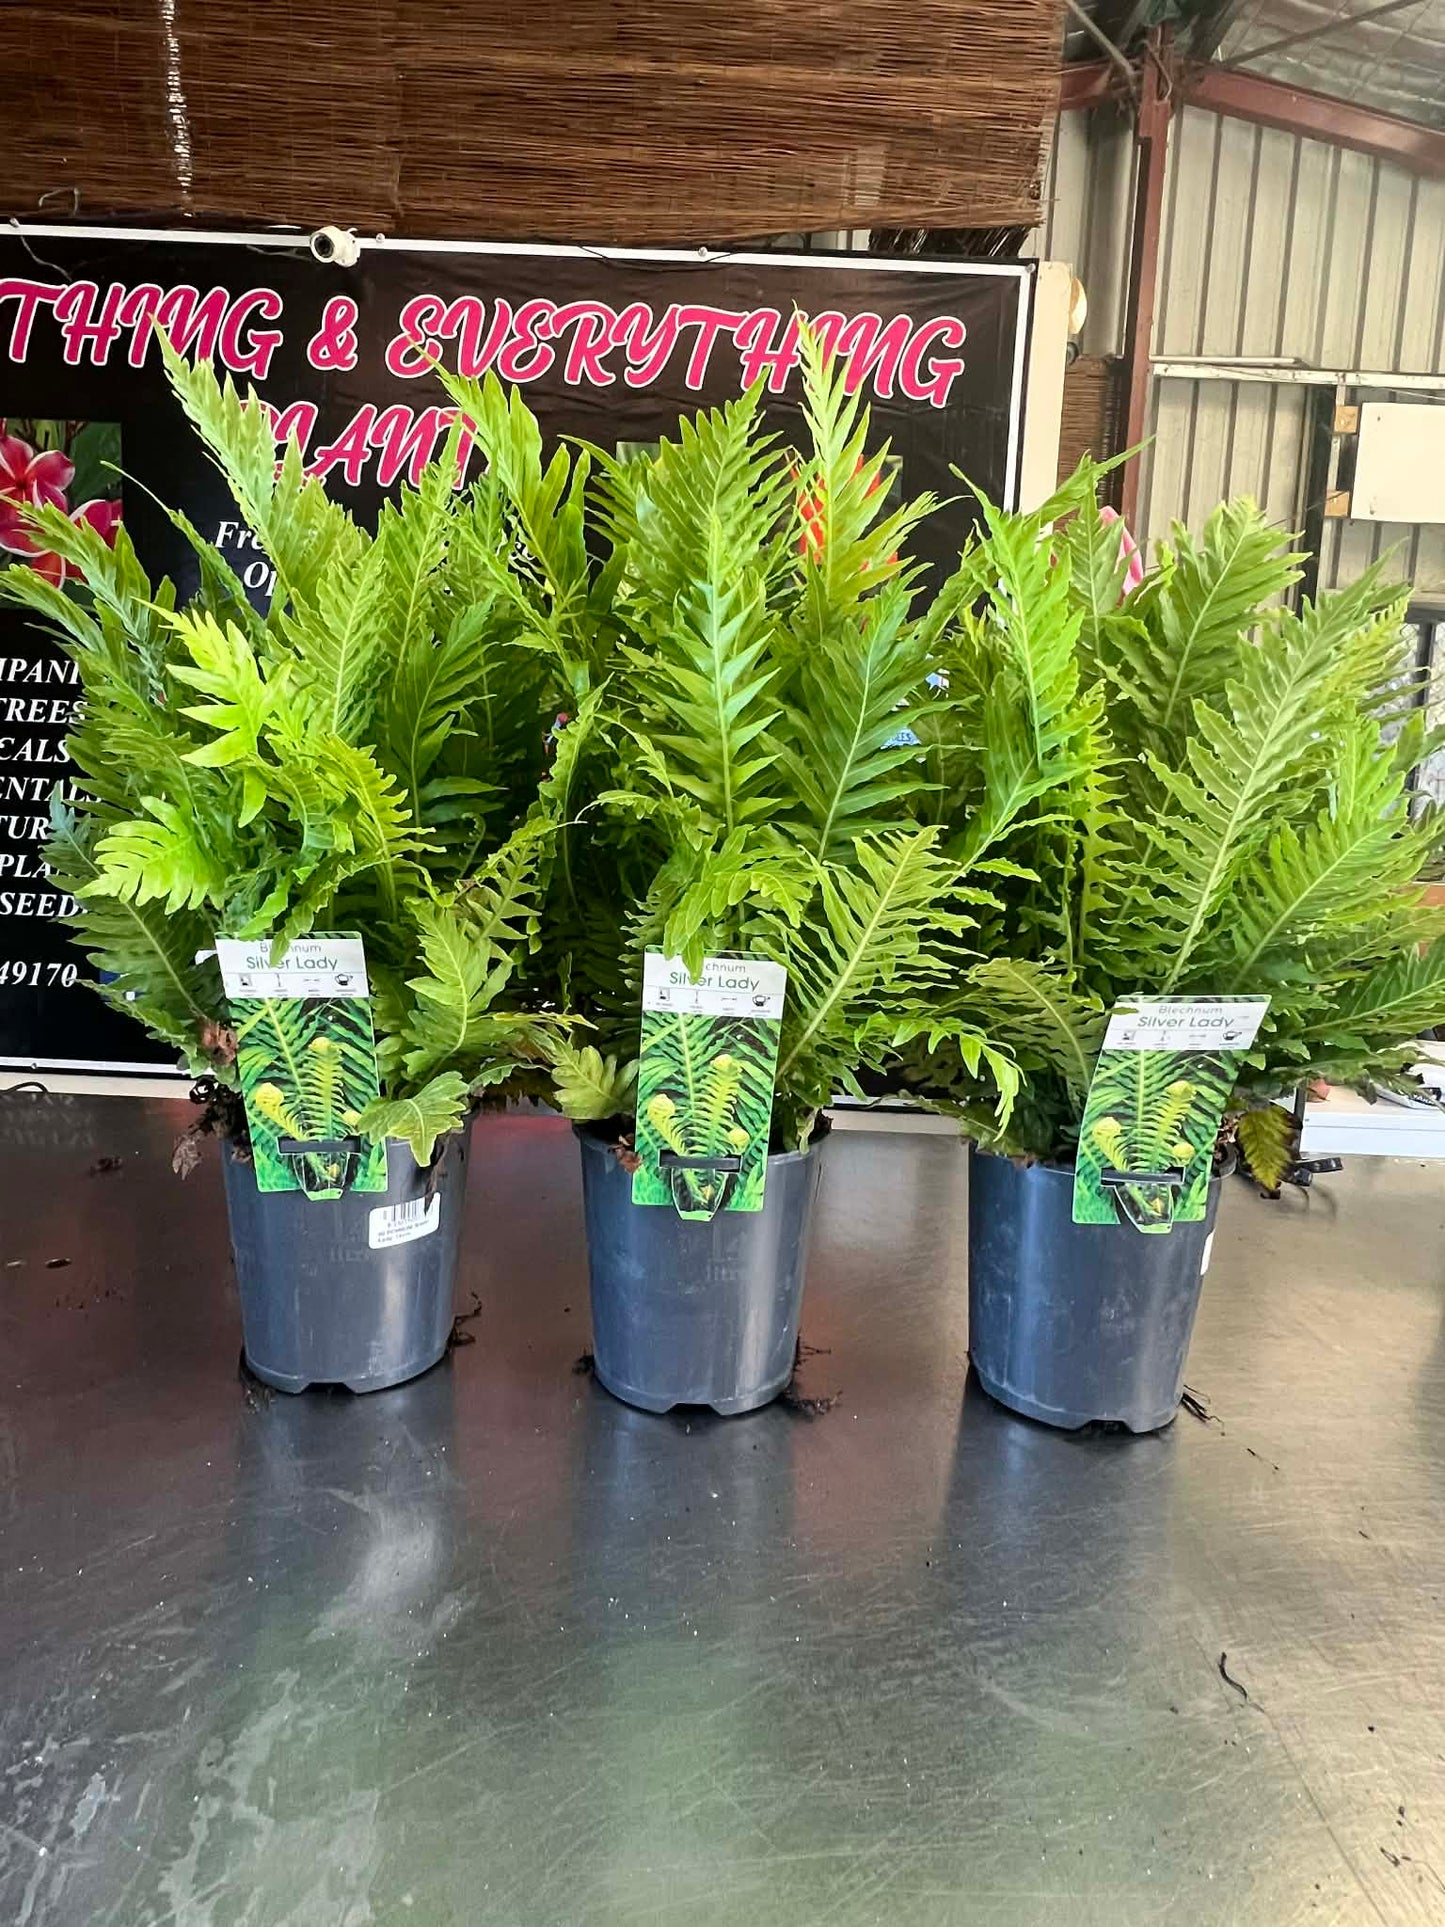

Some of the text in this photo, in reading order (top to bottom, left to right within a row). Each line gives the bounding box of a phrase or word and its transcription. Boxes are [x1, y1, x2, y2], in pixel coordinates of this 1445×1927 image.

[307, 295, 359, 371] &
[385, 294, 967, 408] EVERYTHING
[0, 776, 102, 803] NTAL
[0, 891, 88, 918] SEED
[296, 957, 338, 971] Lady
[669, 971, 760, 991] Siler Lady
[1158, 1005, 1223, 1016] Blechnum
[1137, 1016, 1234, 1028] Silver Lady
